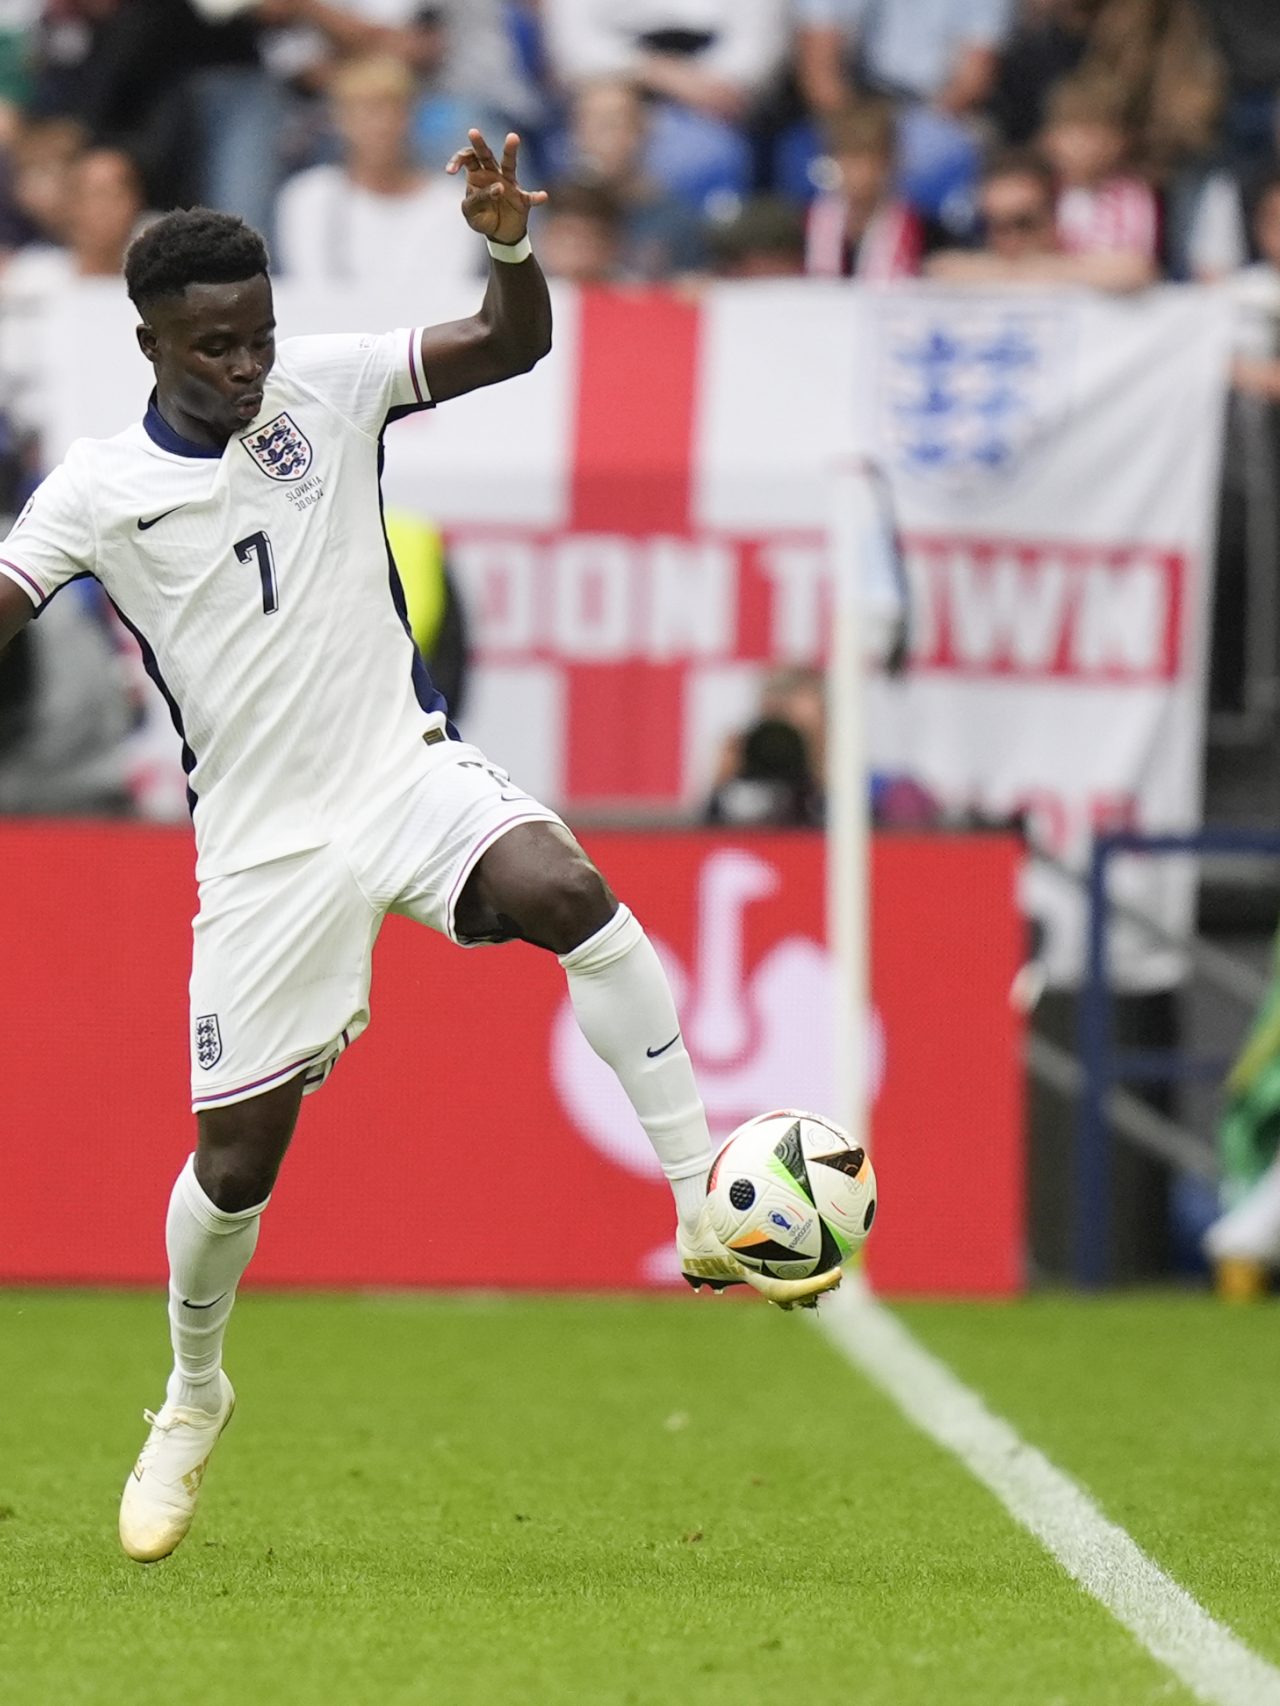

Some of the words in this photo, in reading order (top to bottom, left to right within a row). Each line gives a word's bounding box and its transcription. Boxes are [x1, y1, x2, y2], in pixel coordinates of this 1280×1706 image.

[285, 476, 323, 502] SLOVAKIA
[233, 530, 279, 616] 7
[750, 548, 1162, 678] TWN
